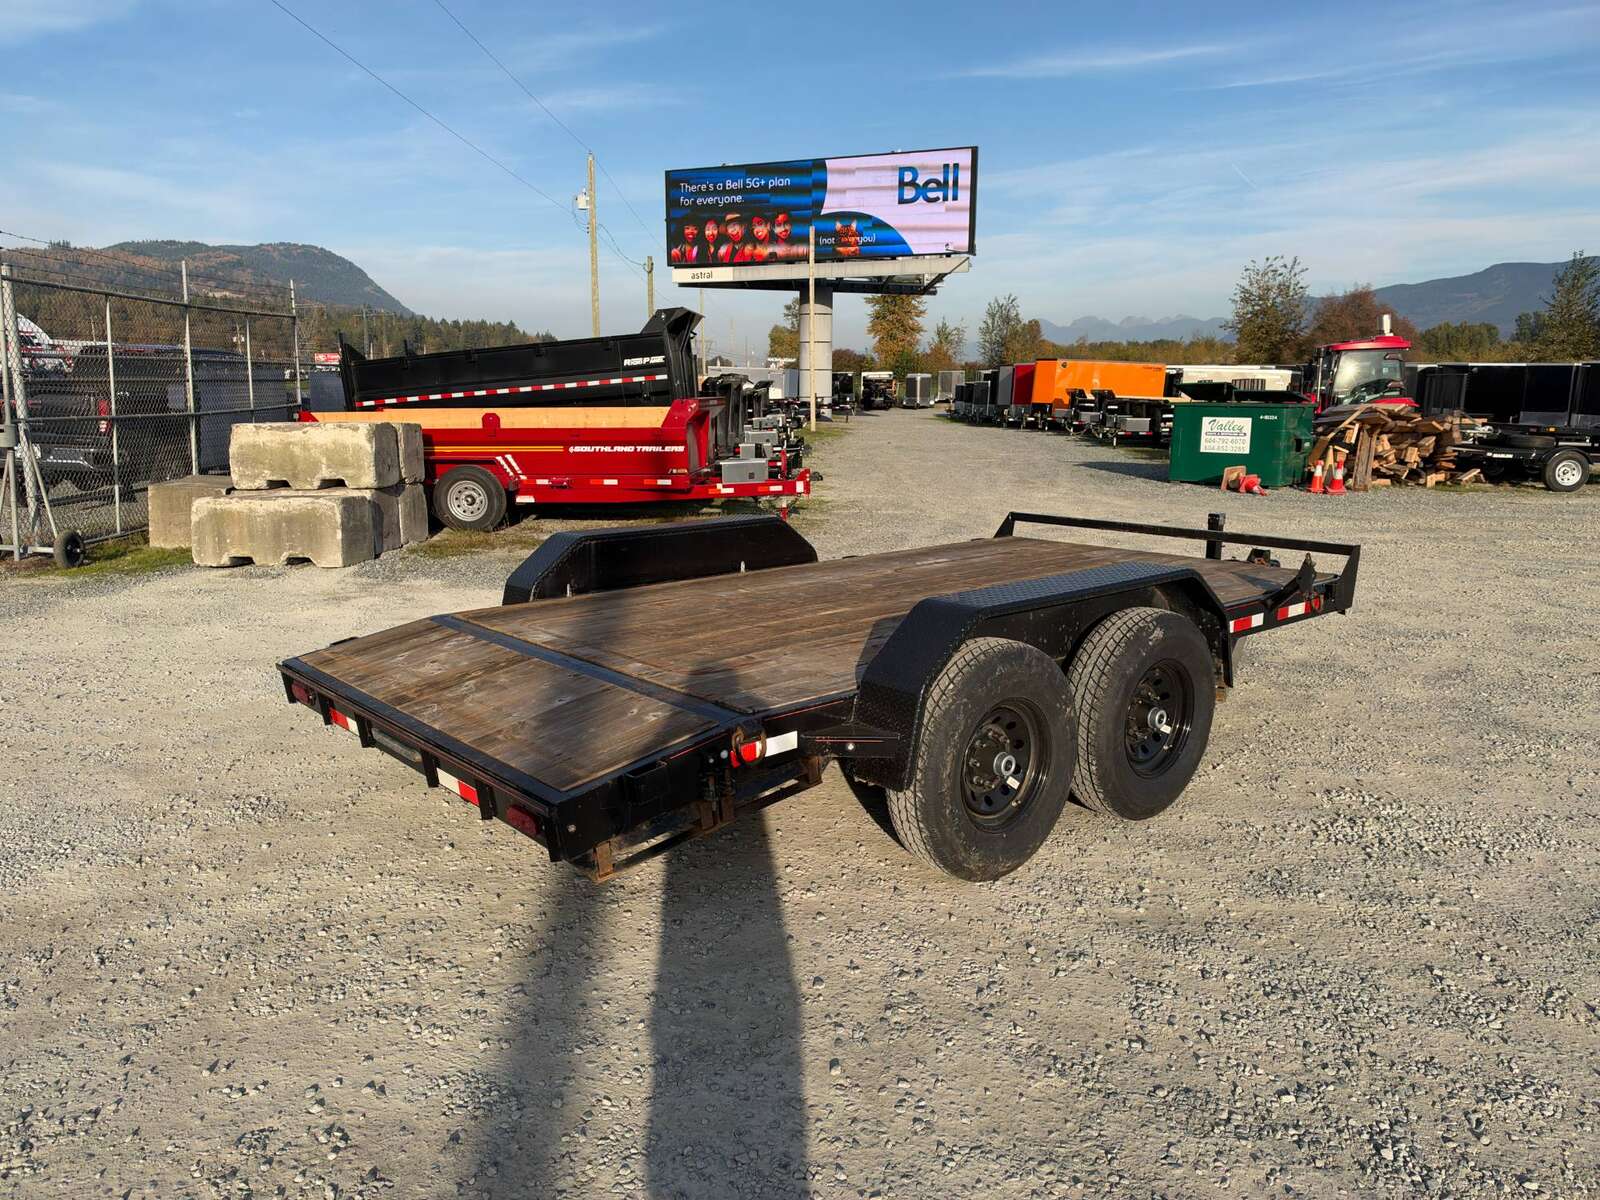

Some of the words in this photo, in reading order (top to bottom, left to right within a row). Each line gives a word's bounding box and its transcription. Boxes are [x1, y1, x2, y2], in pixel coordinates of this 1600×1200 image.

[679, 182, 714, 193] There's
[716, 183, 723, 191] a
[725, 179, 743, 190] Bell
[745, 177, 765, 189] 5G+
[768, 176, 791, 189] plan
[897, 162, 960, 205] Bell
[679, 196, 695, 206] for
[696, 195, 745, 207] everyone.
[819, 235, 836, 245] (not
[690, 271, 713, 280] astral
[1208, 419, 1245, 433] Valley
[573, 445, 635, 453] SOUTHLAND
[635, 445, 685, 453] TRAILERS
